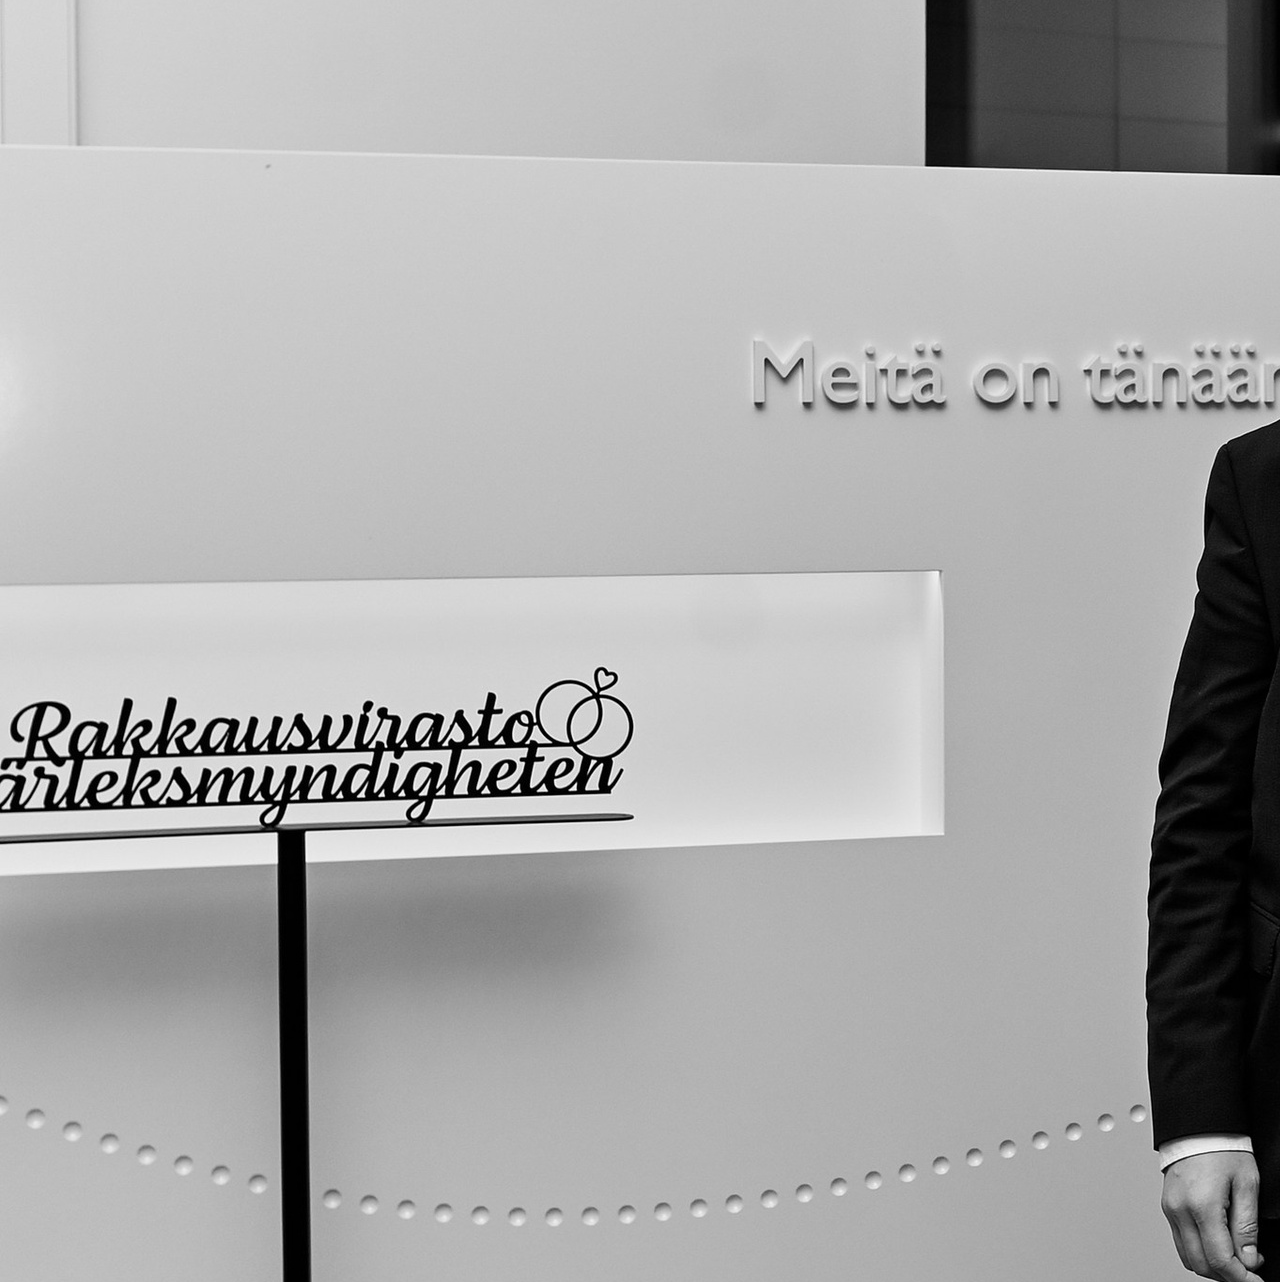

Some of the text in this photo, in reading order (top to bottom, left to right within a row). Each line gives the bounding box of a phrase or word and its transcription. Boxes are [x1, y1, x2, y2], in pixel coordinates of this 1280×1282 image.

[752, 338, 948, 409] Meitä
[974, 362, 1060, 409] on
[10, 693, 537, 767] Rakkausvirasto
